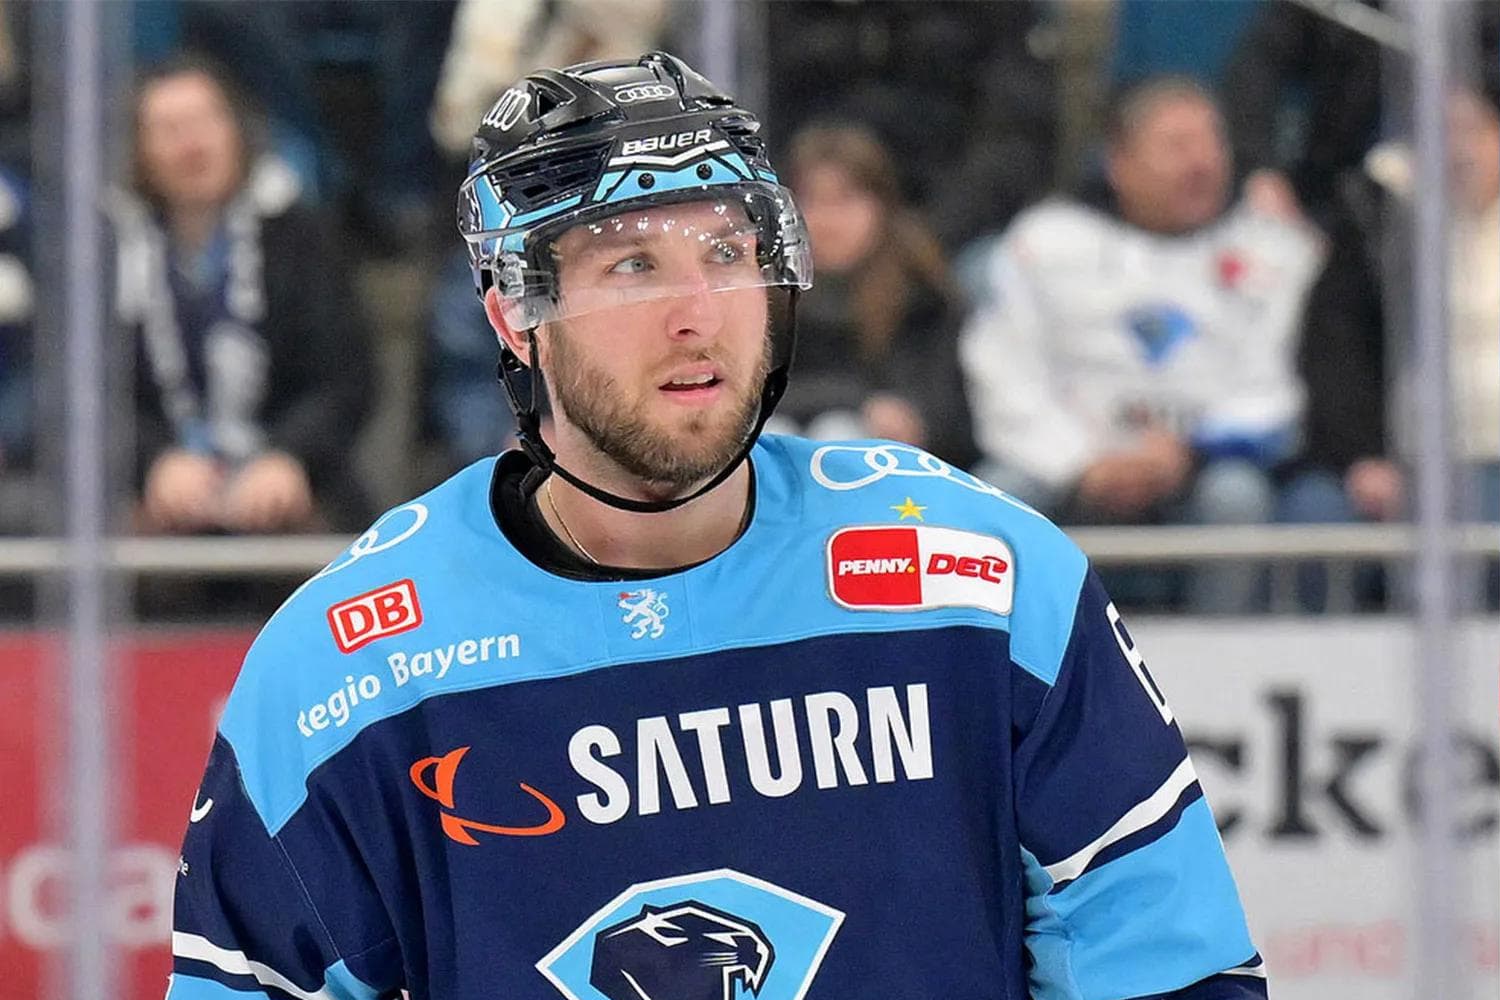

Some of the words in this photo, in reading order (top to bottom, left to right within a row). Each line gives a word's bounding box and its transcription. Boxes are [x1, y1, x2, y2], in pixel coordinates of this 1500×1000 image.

[338, 589, 410, 643] DB
[387, 632, 521, 689] Bayern
[566, 683, 935, 825] SATURN
